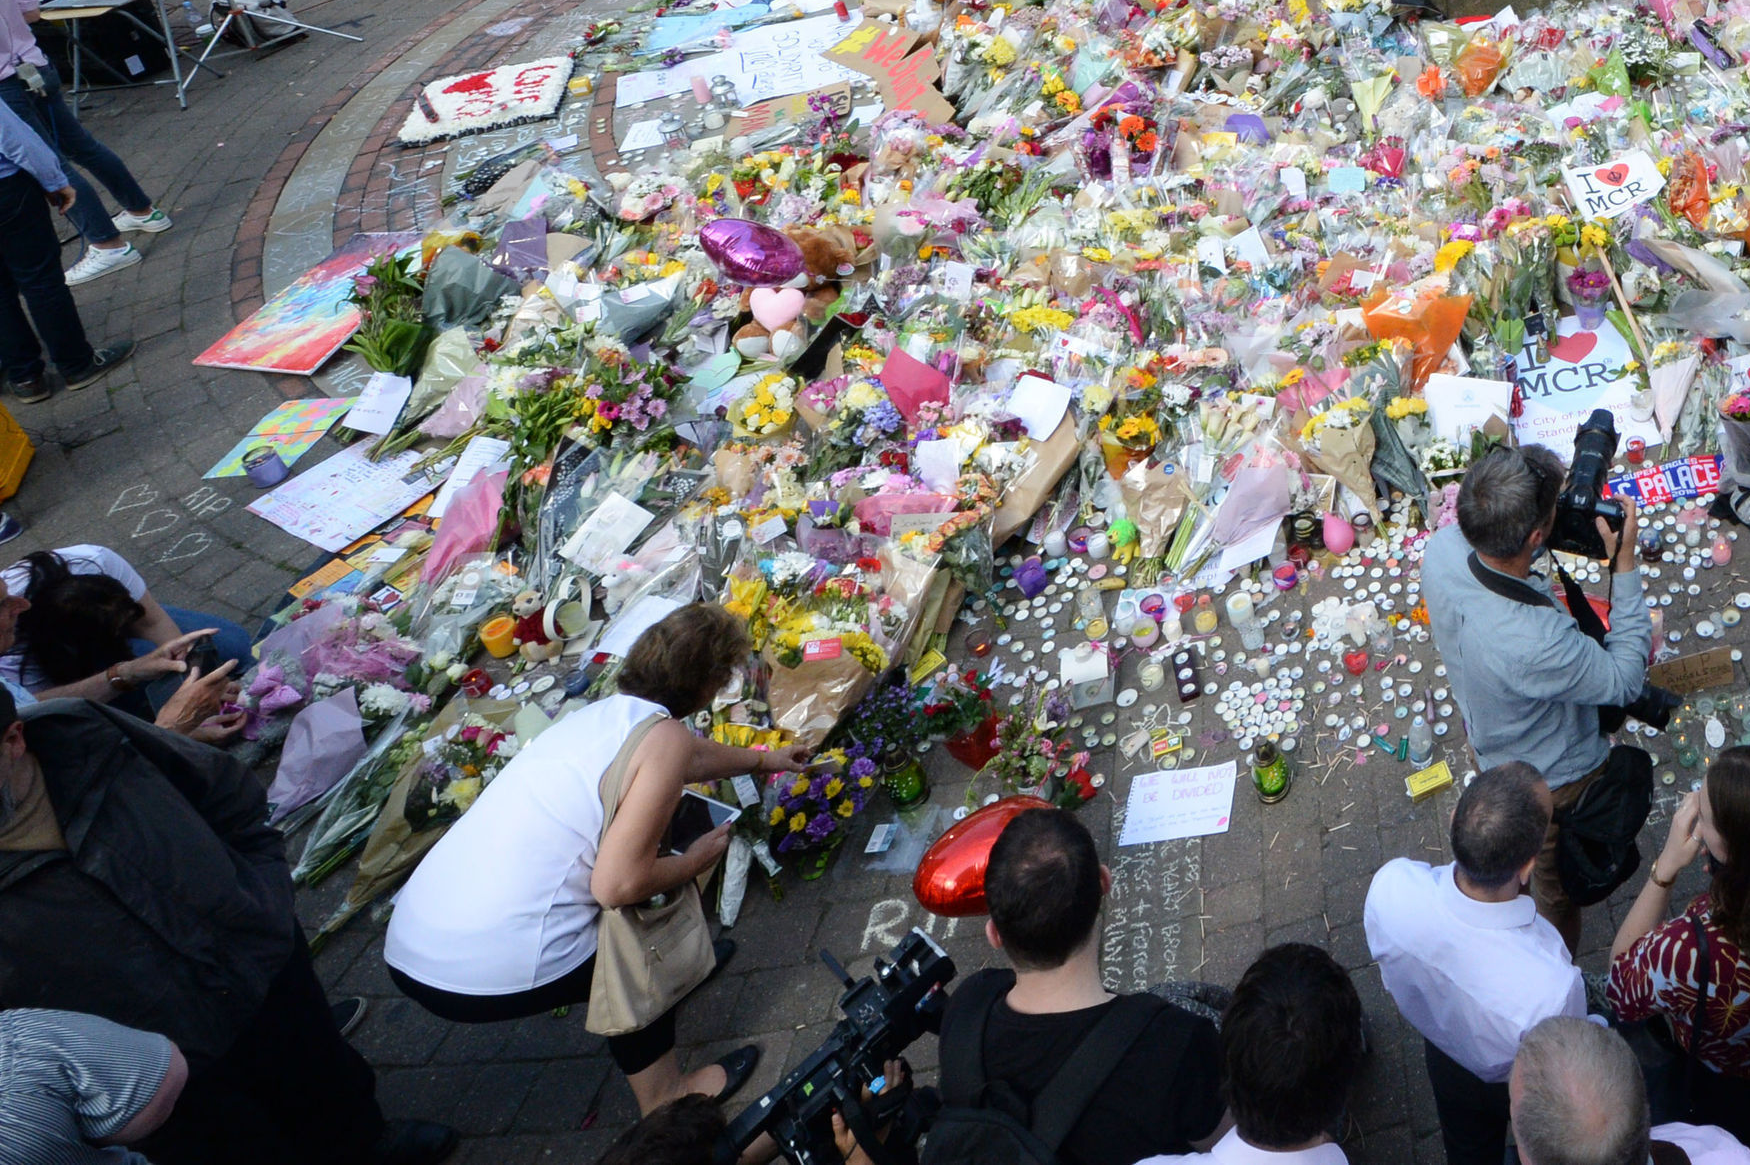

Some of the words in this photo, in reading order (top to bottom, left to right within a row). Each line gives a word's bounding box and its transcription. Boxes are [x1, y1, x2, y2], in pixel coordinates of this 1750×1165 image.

[1577, 173, 1601, 194] I
[1585, 180, 1648, 215] MCR
[1520, 342, 1546, 373] I
[1517, 361, 1620, 401] MCR
[1533, 414, 1557, 427] City
[1562, 409, 1574, 420] of
[1622, 467, 1657, 481] SUPER
[1660, 457, 1698, 471] EAGLES
[183, 486, 232, 517] RIP
[1140, 775, 1159, 788] WE
[1171, 771, 1198, 784] WILL
[1207, 766, 1235, 781] NOT
[1142, 791, 1158, 803] BE
[1172, 782, 1224, 801] DIVIDED
